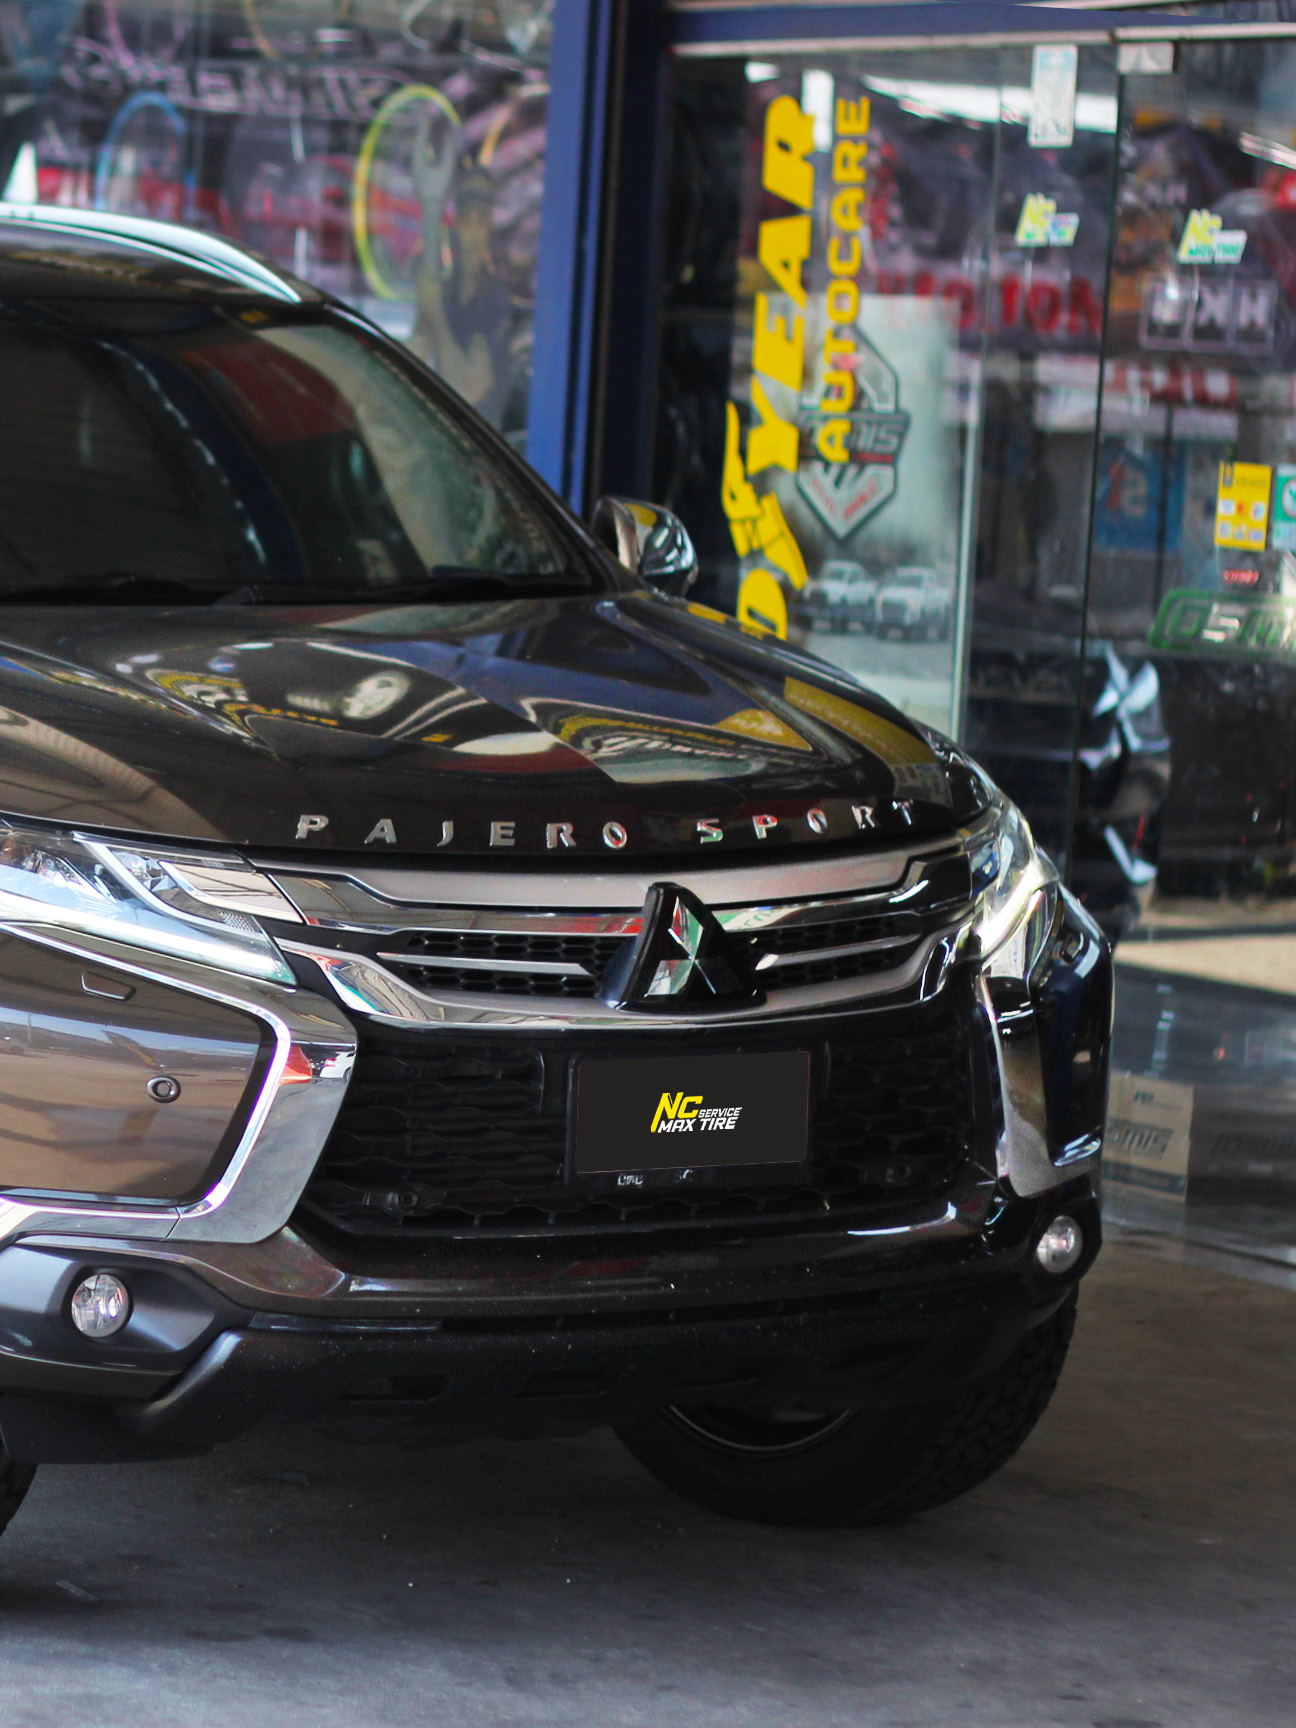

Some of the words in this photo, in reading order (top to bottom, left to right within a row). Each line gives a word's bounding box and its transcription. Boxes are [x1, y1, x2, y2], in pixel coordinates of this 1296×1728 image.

[816, 96, 871, 463] AUTOCARE
[295, 813, 628, 849] PAJERO
[697, 799, 915, 844] SPORT
